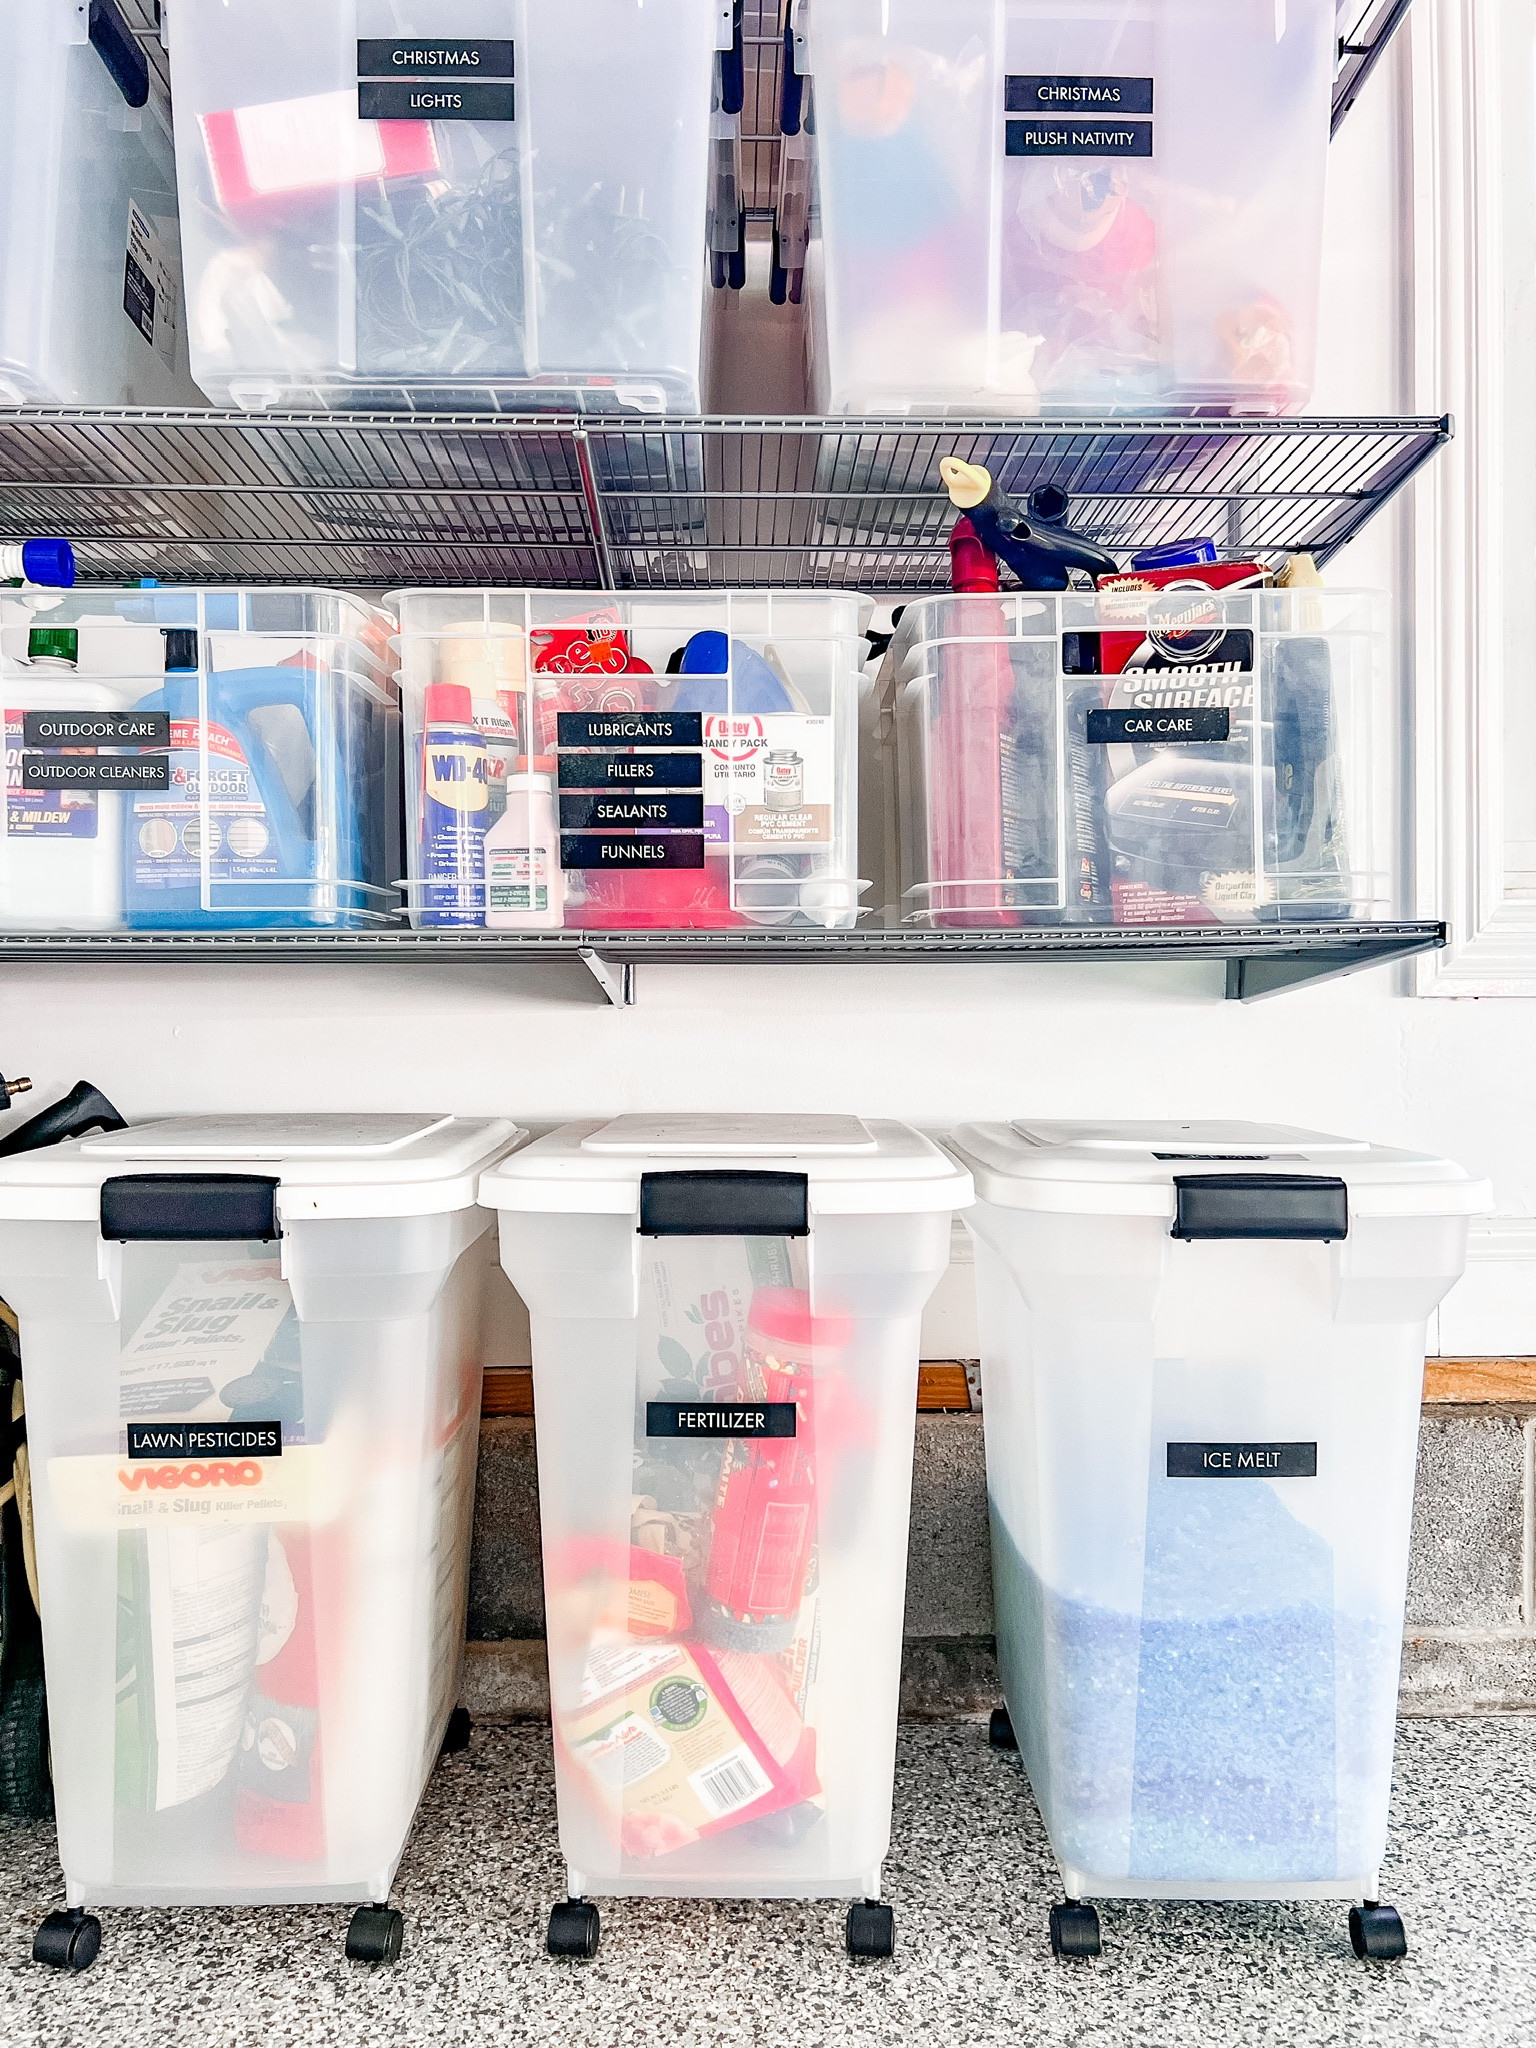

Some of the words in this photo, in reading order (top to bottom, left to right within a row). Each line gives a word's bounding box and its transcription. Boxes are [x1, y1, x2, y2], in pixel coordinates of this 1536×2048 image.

[393, 51, 479, 64] CHRISTMAS
[1038, 87, 1120, 101] CHRISTMAS
[411, 95, 461, 107] LIGHTS
[1026, 132, 1066, 144] PLUSH
[1073, 132, 1134, 144] NATIVITY
[1112, 584, 1142, 593] INCLUDES
[1123, 661, 1242, 693] SMOOTH
[1134, 686, 1254, 709] SURFACE
[481, 716, 489, 726] IT
[491, 718, 512, 728] RIGHT
[718, 720, 750, 736] Otey
[1125, 720, 1152, 732] CAR
[1157, 719, 1192, 731] CARE
[40, 724, 114, 735] OUTDOOR
[119, 723, 155, 735] CARE
[589, 724, 672, 735] LUBRICANTS
[740, 739, 768, 748] PACK
[29, 766, 96, 777] OUTDOOR
[100, 767, 164, 778] CLEANERS
[608, 765, 653, 776] FILLERS
[1161, 781, 1173, 789] THE
[1174, 782, 1213, 793] DIFFERENCE
[22, 811, 70, 824] MILDEW
[598, 805, 667, 817] SEALANTS
[602, 846, 664, 858] FUNNELS
[1215, 891, 1239, 901] Liquid
[1240, 890, 1256, 901] Clay
[159, 1293, 267, 1318] Snail
[257, 1298, 278, 1310] &
[144, 1314, 239, 1339] Slug
[679, 1413, 764, 1428] FERTILIZER
[134, 1434, 182, 1447] LAWN
[190, 1432, 276, 1447] PESTICIDES
[1204, 1453, 1231, 1467] ICE
[1238, 1453, 1280, 1467] MELT
[118, 1460, 263, 1491] VIGORO
[118, 1500, 153, 1516] nail
[158, 1502, 170, 1514] &
[173, 1498, 212, 1514] Slug
[216, 1499, 244, 1511] Killer
